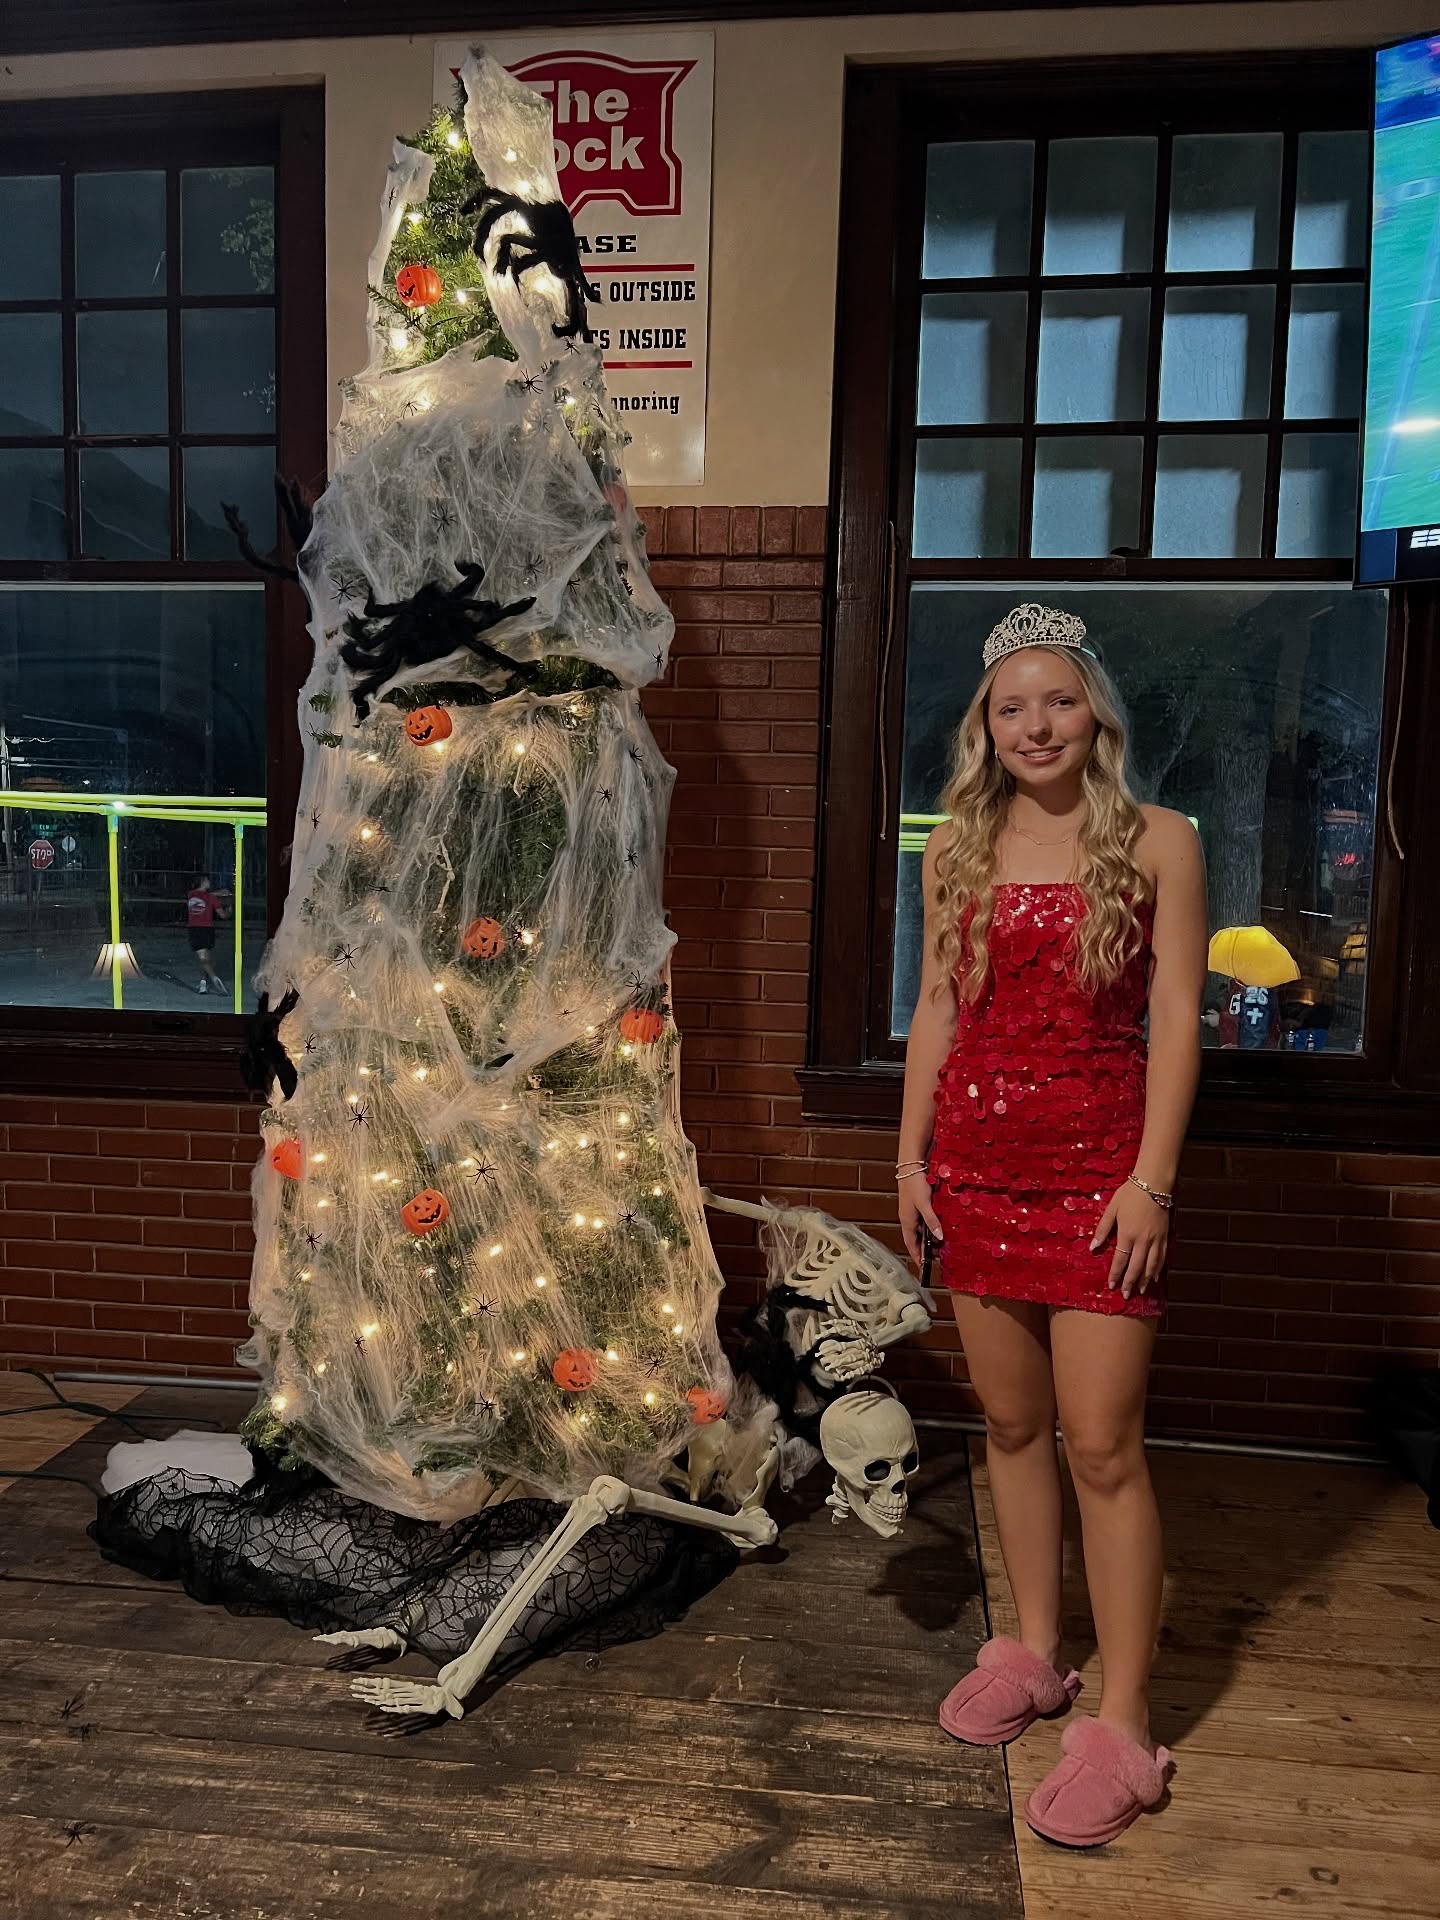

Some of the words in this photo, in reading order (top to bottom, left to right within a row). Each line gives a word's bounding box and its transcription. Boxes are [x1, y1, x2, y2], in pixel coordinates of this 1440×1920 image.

[554, 126, 645, 171] ock
[575, 234, 637, 254] ASE
[610, 281, 696, 302] OUTSIDE
[619, 328, 686, 350] INSIDE
[611, 391, 680, 413] noring
[1410, 529, 1440, 549] ES
[31, 848, 52, 860] STOP
